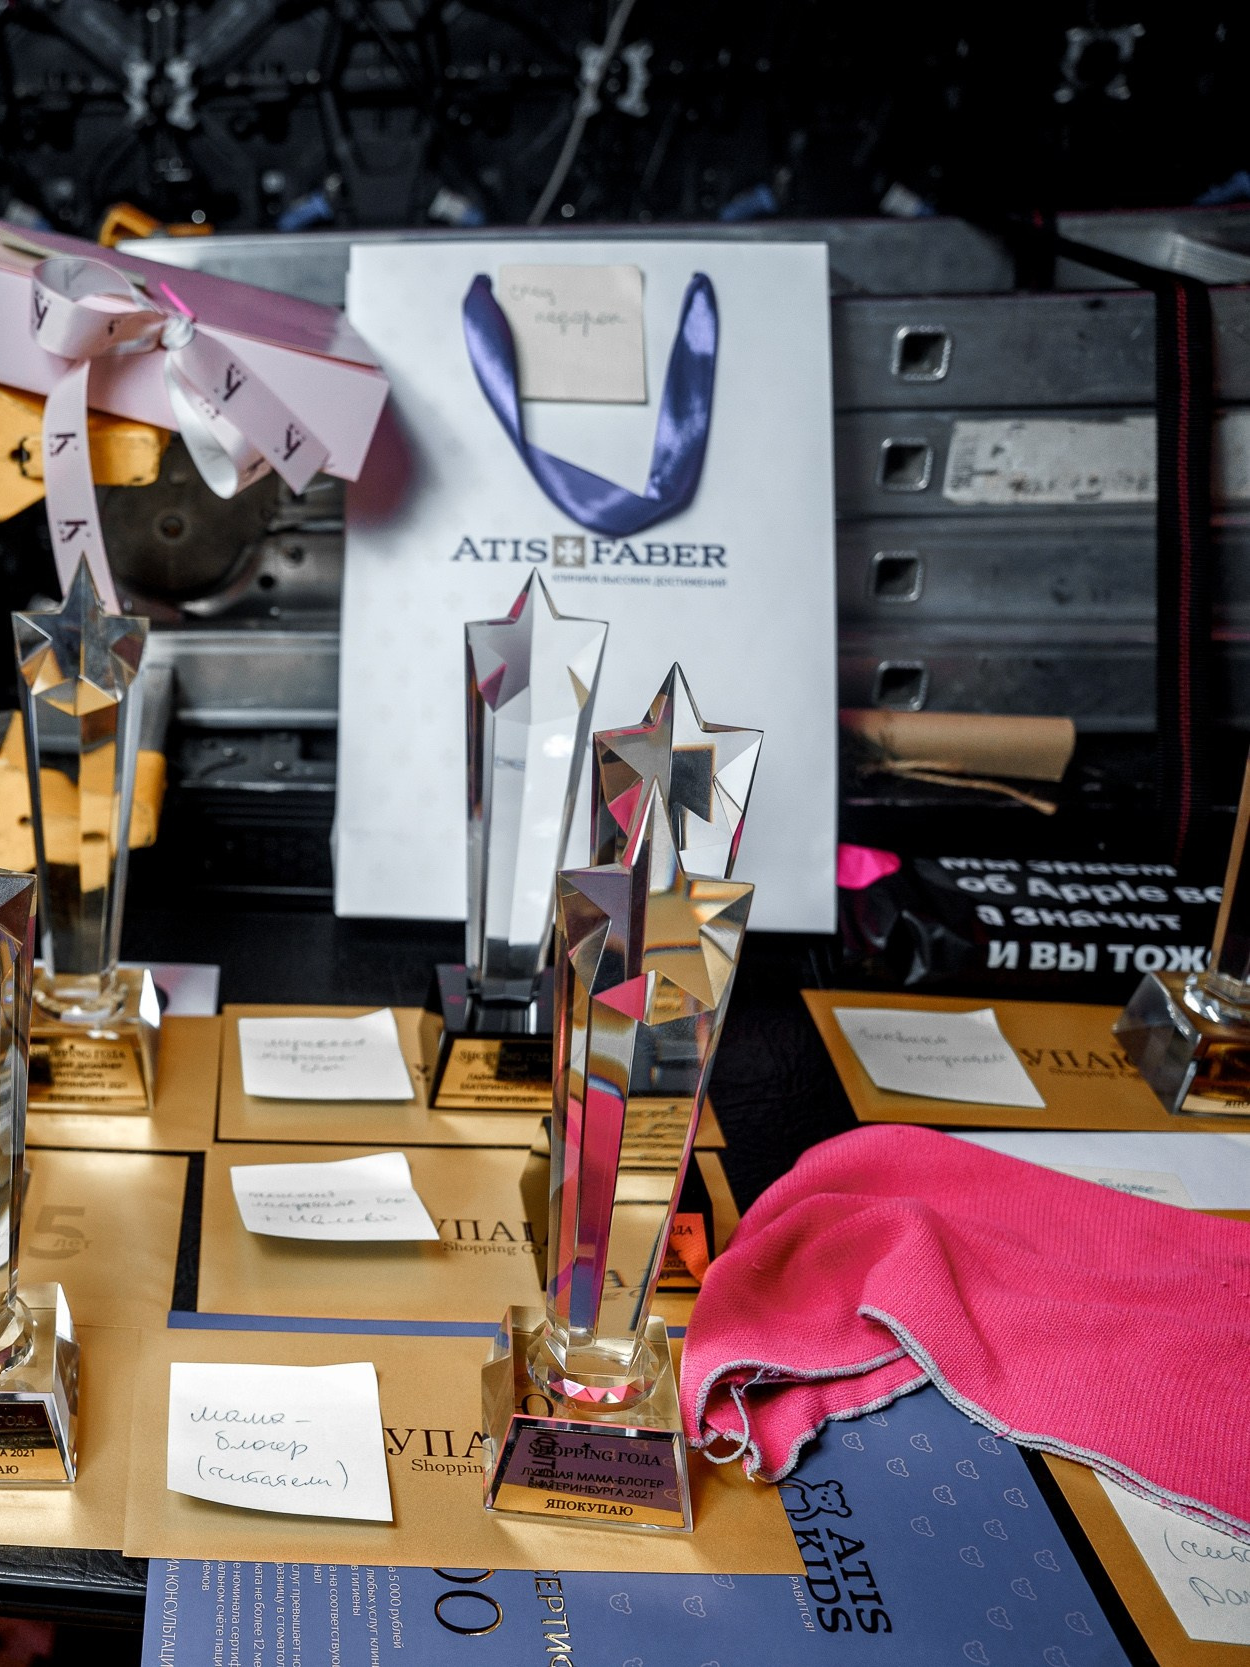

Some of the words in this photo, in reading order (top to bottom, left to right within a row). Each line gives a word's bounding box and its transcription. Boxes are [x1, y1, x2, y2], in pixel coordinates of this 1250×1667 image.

[450, 536, 548, 563] ATIS
[591, 539, 728, 568] FABER
[1026, 876, 1169, 906] Apple
[444, 1240, 518, 1256] Shopping
[10, 1448, 36, 1458] 2021
[215, 1430, 308, 1461] блогер
[527, 1442, 613, 1463] SHOPPING
[613, 1451, 662, 1467] ГОДА
[527, 1479, 625, 1498] ЕКАТЕРИНБУРГА
[627, 1488, 655, 1500] 2021
[577, 1472, 665, 1488] МАМА-БЛОГЕР
[544, 1497, 634, 1517] ЯПОКУПАЮ
[254, 1562, 264, 1585] ката
[289, 1563, 300, 1587] слуг
[313, 1565, 323, 1584] нал
[365, 1567, 379, 1604] любых
[793, 1527, 853, 1633] KIDS
[825, 1527, 893, 1634] ATIS
[231, 1570, 241, 1624] номинала
[254, 1586, 263, 1601] не
[788, 1575, 816, 1633] РАВИТСЯ!
[215, 1603, 227, 1636] счёте
[254, 1602, 266, 1636] более
[290, 1588, 301, 1652] превышает
[329, 1588, 341, 1667] соответствую
[366, 1604, 379, 1636] услуг
[388, 1607, 405, 1650] рублей
[253, 1637, 265, 1650] 12
[276, 1615, 285, 1667] стоматол
[370, 1637, 380, 1667] клин
